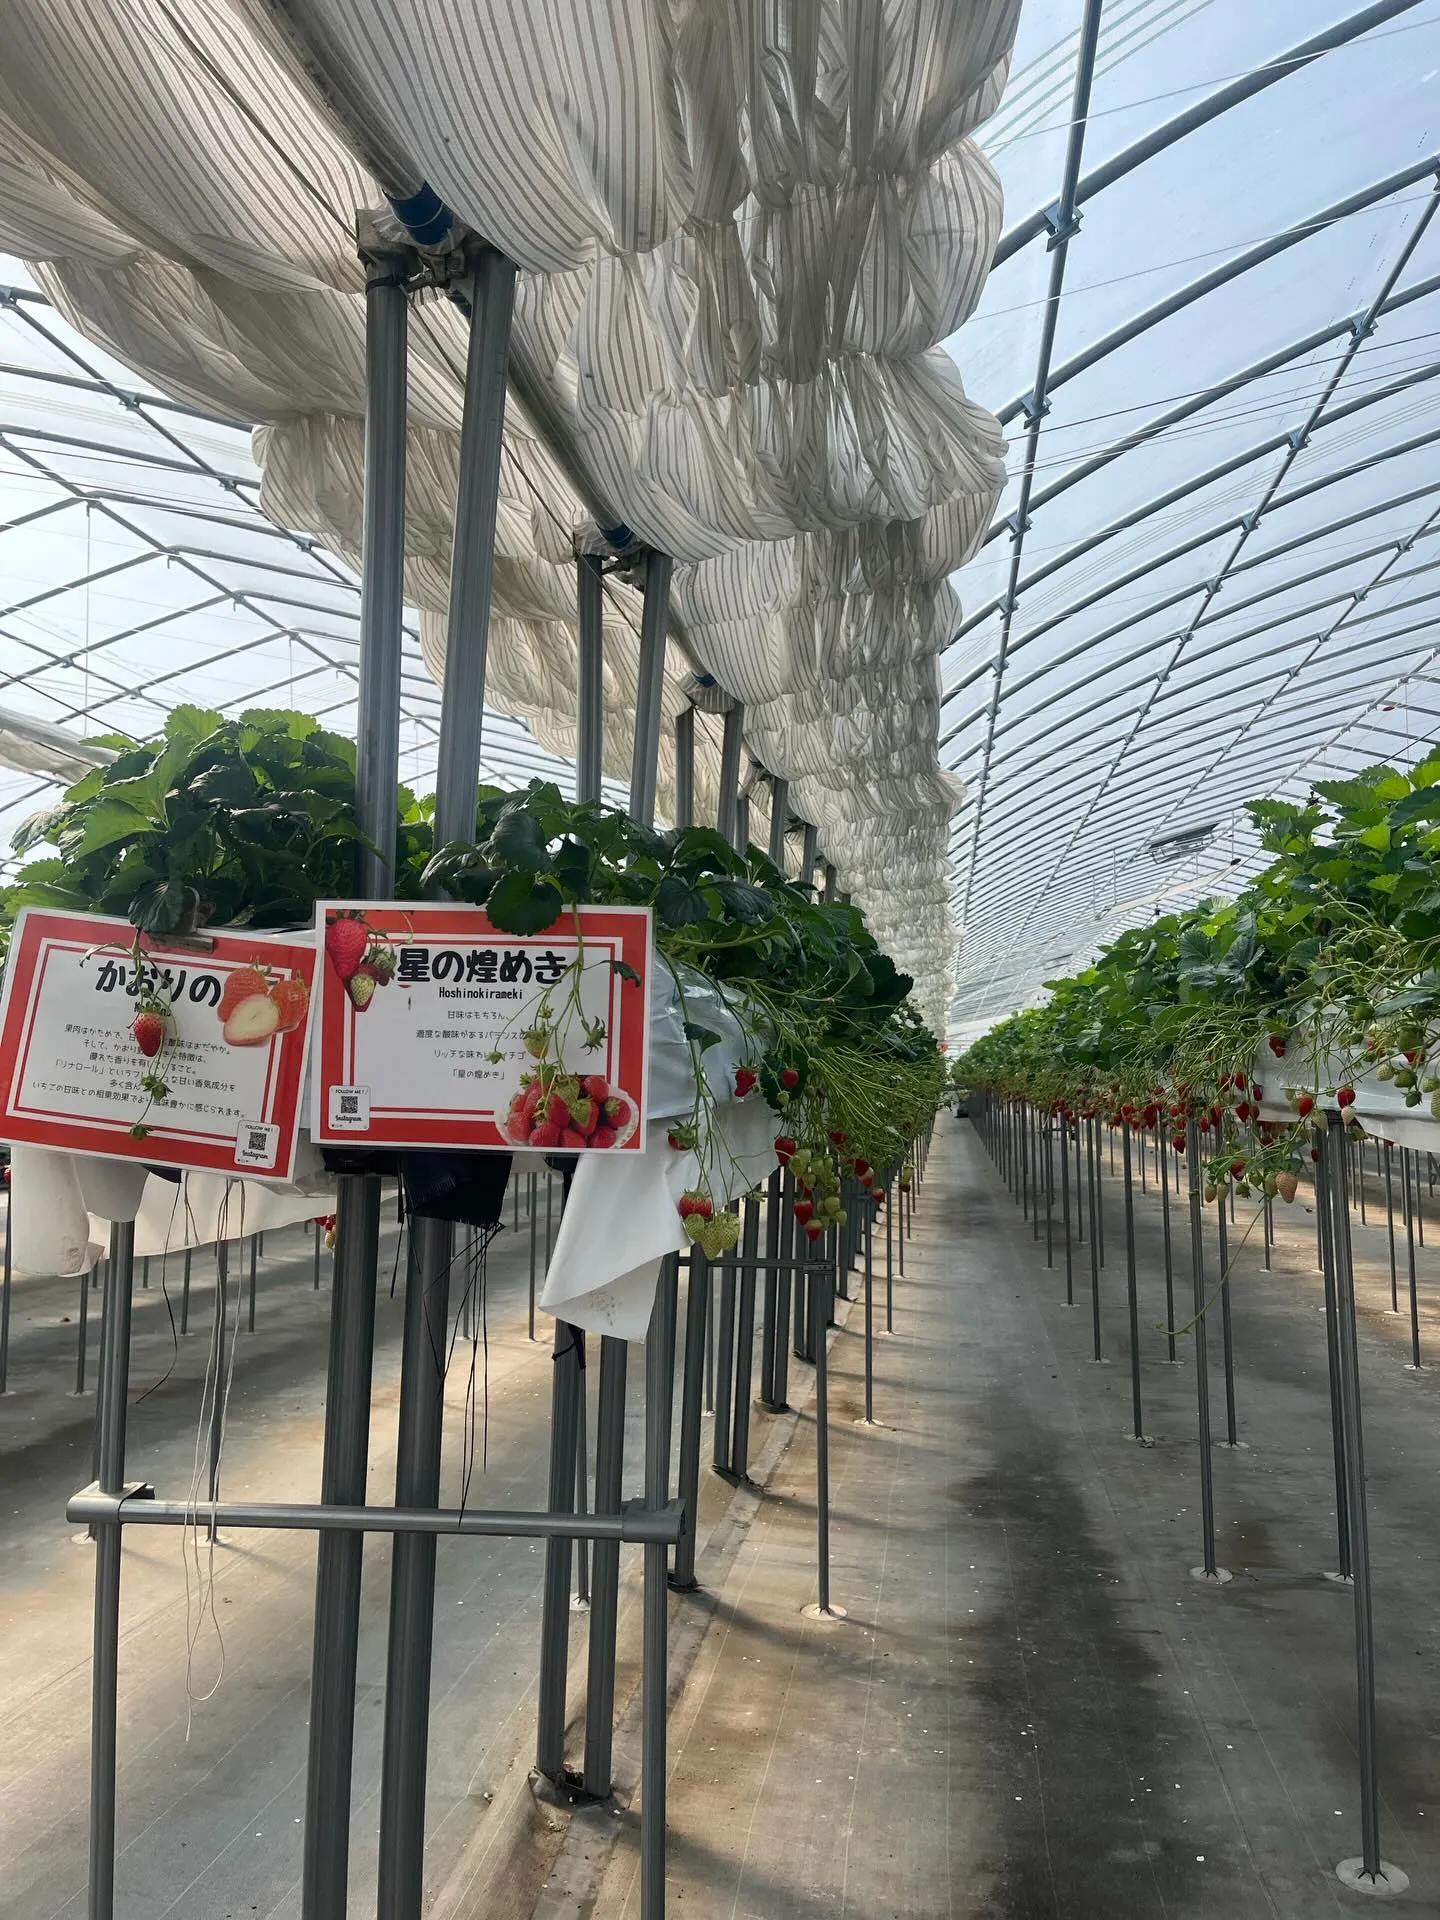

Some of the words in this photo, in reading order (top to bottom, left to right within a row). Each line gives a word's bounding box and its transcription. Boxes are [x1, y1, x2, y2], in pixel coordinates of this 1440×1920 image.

[397, 947, 568, 984] 星の煌めき
[438, 987, 523, 1000] Hoshinokirameki
[434, 1049, 527, 1060] リッチな味わイチゴ
